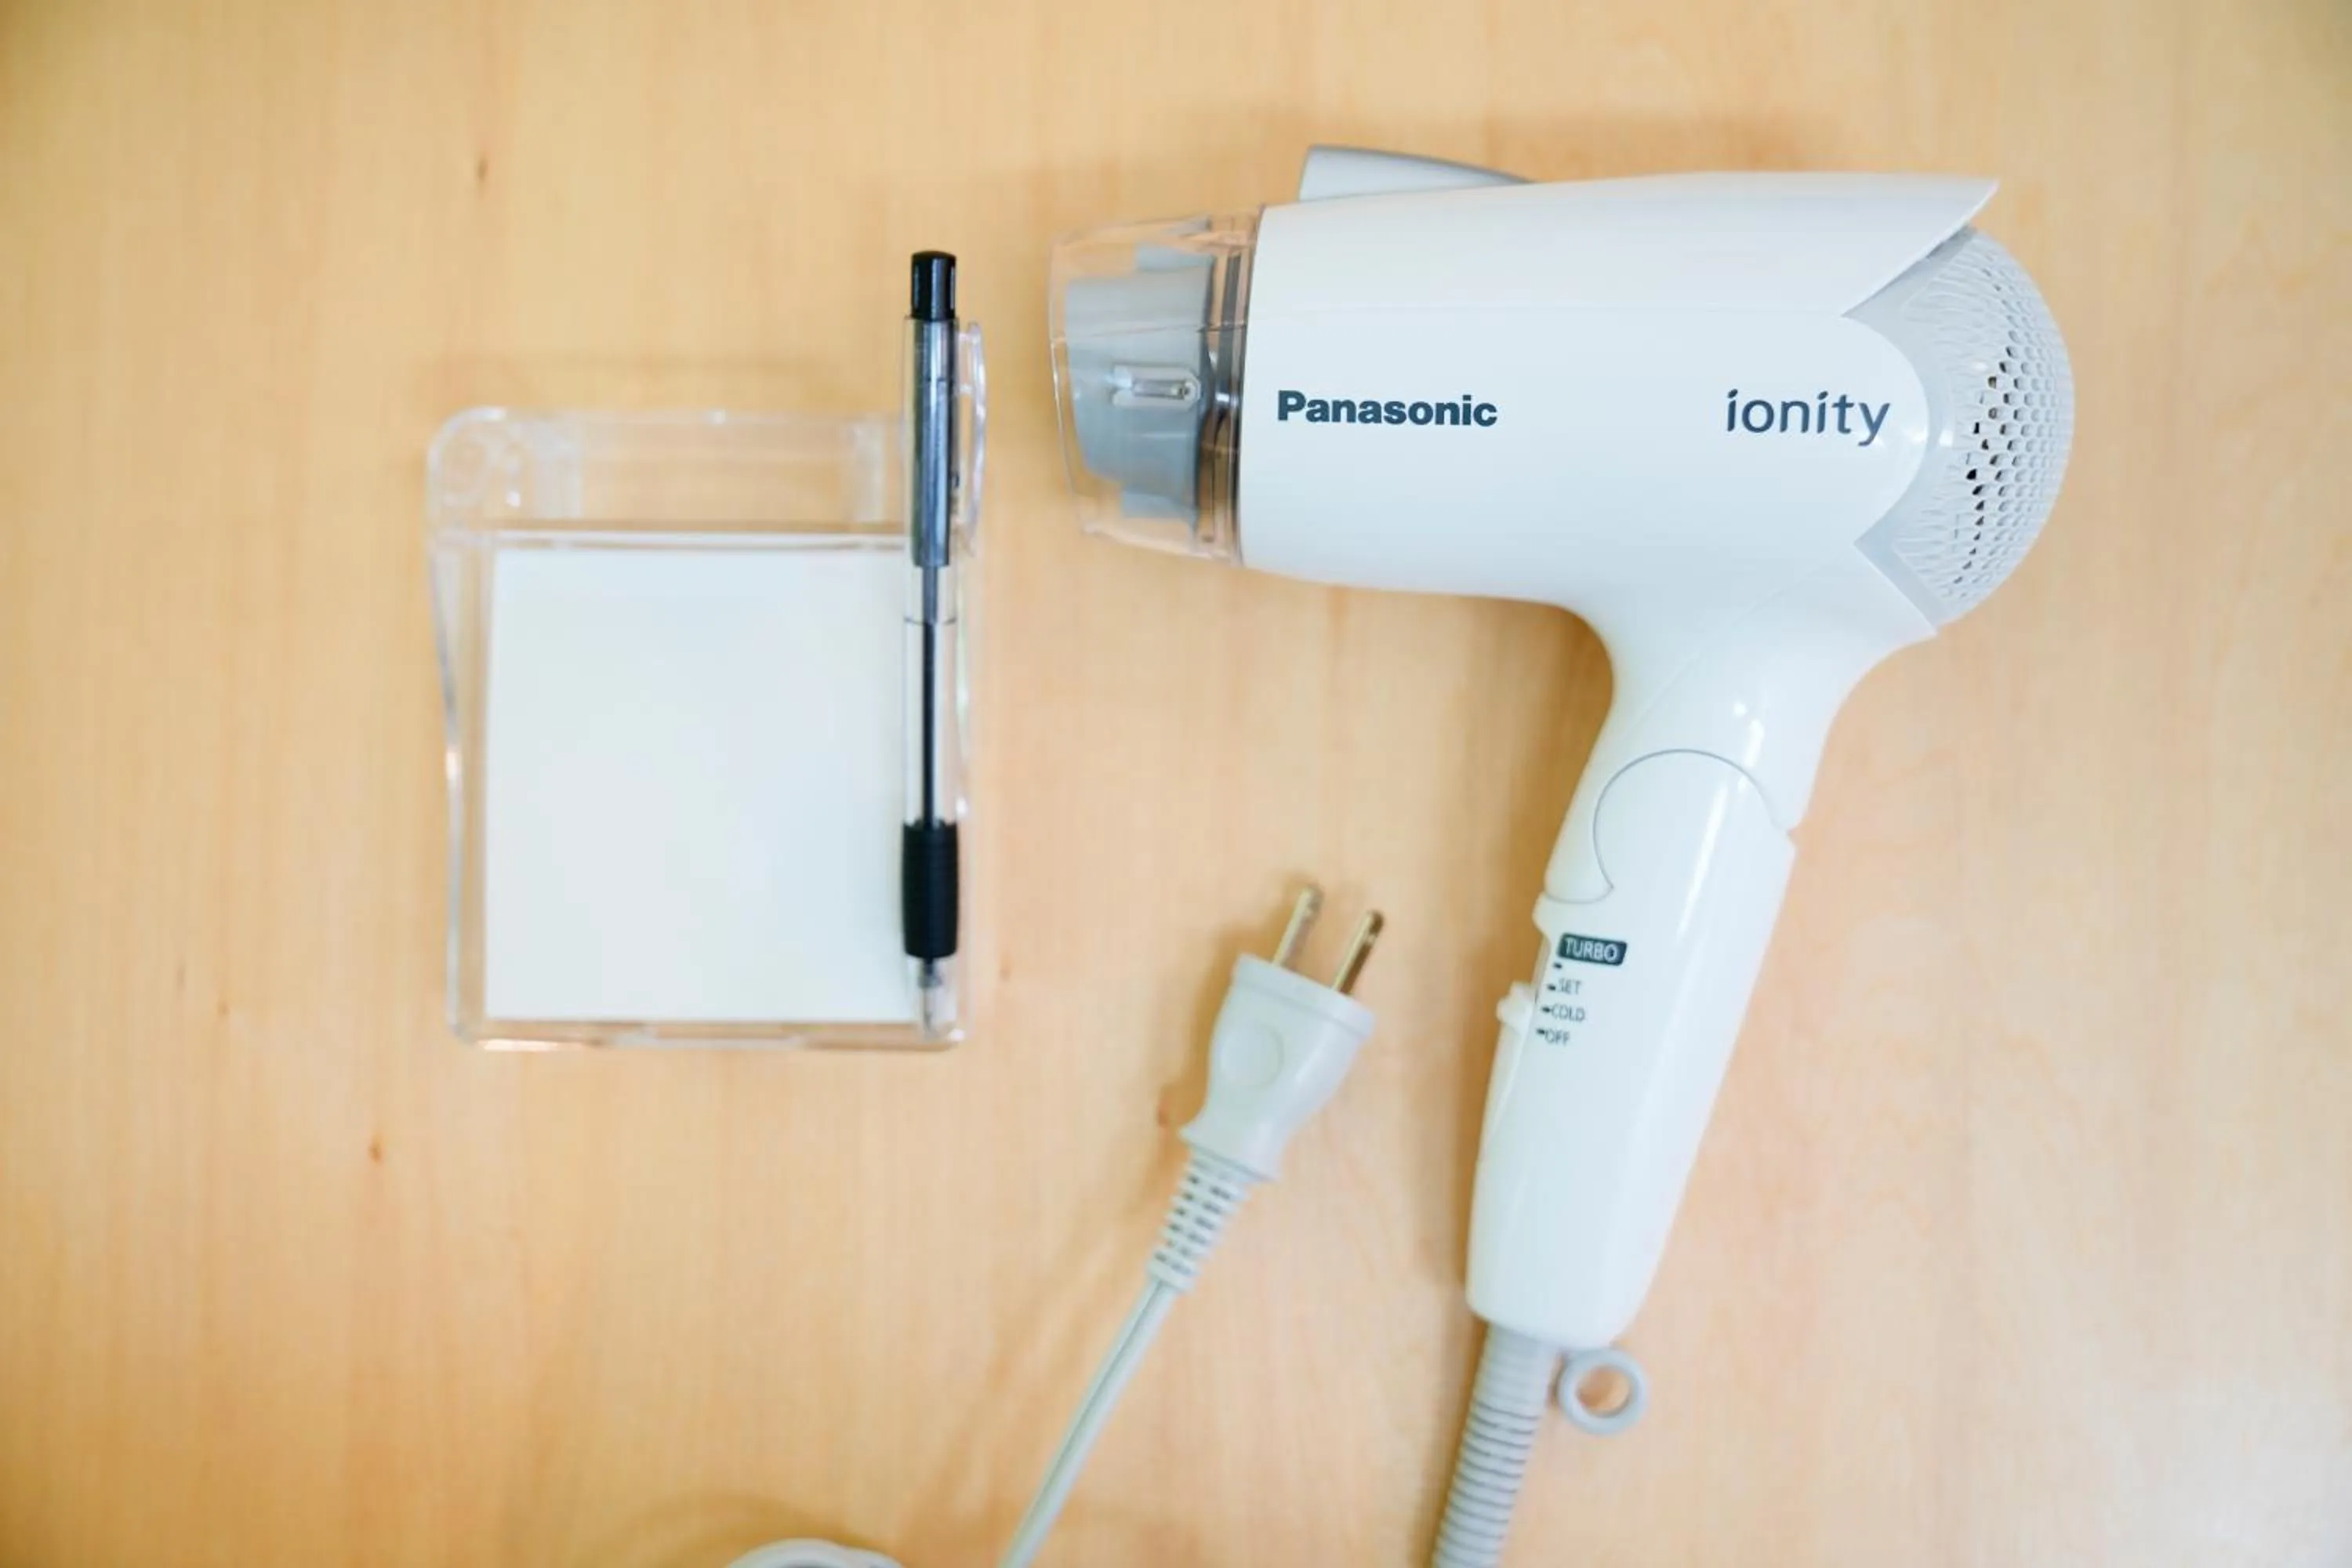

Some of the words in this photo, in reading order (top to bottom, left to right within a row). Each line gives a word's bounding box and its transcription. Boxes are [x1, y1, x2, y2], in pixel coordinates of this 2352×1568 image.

[1277, 390, 1497, 426] Panasonic
[1726, 388, 1890, 446] ionity
[1565, 937, 1620, 963] TURBO
[1556, 978, 1581, 995] SET
[1551, 1004, 1585, 1022] COLD
[1545, 1028, 1571, 1046] OFF
